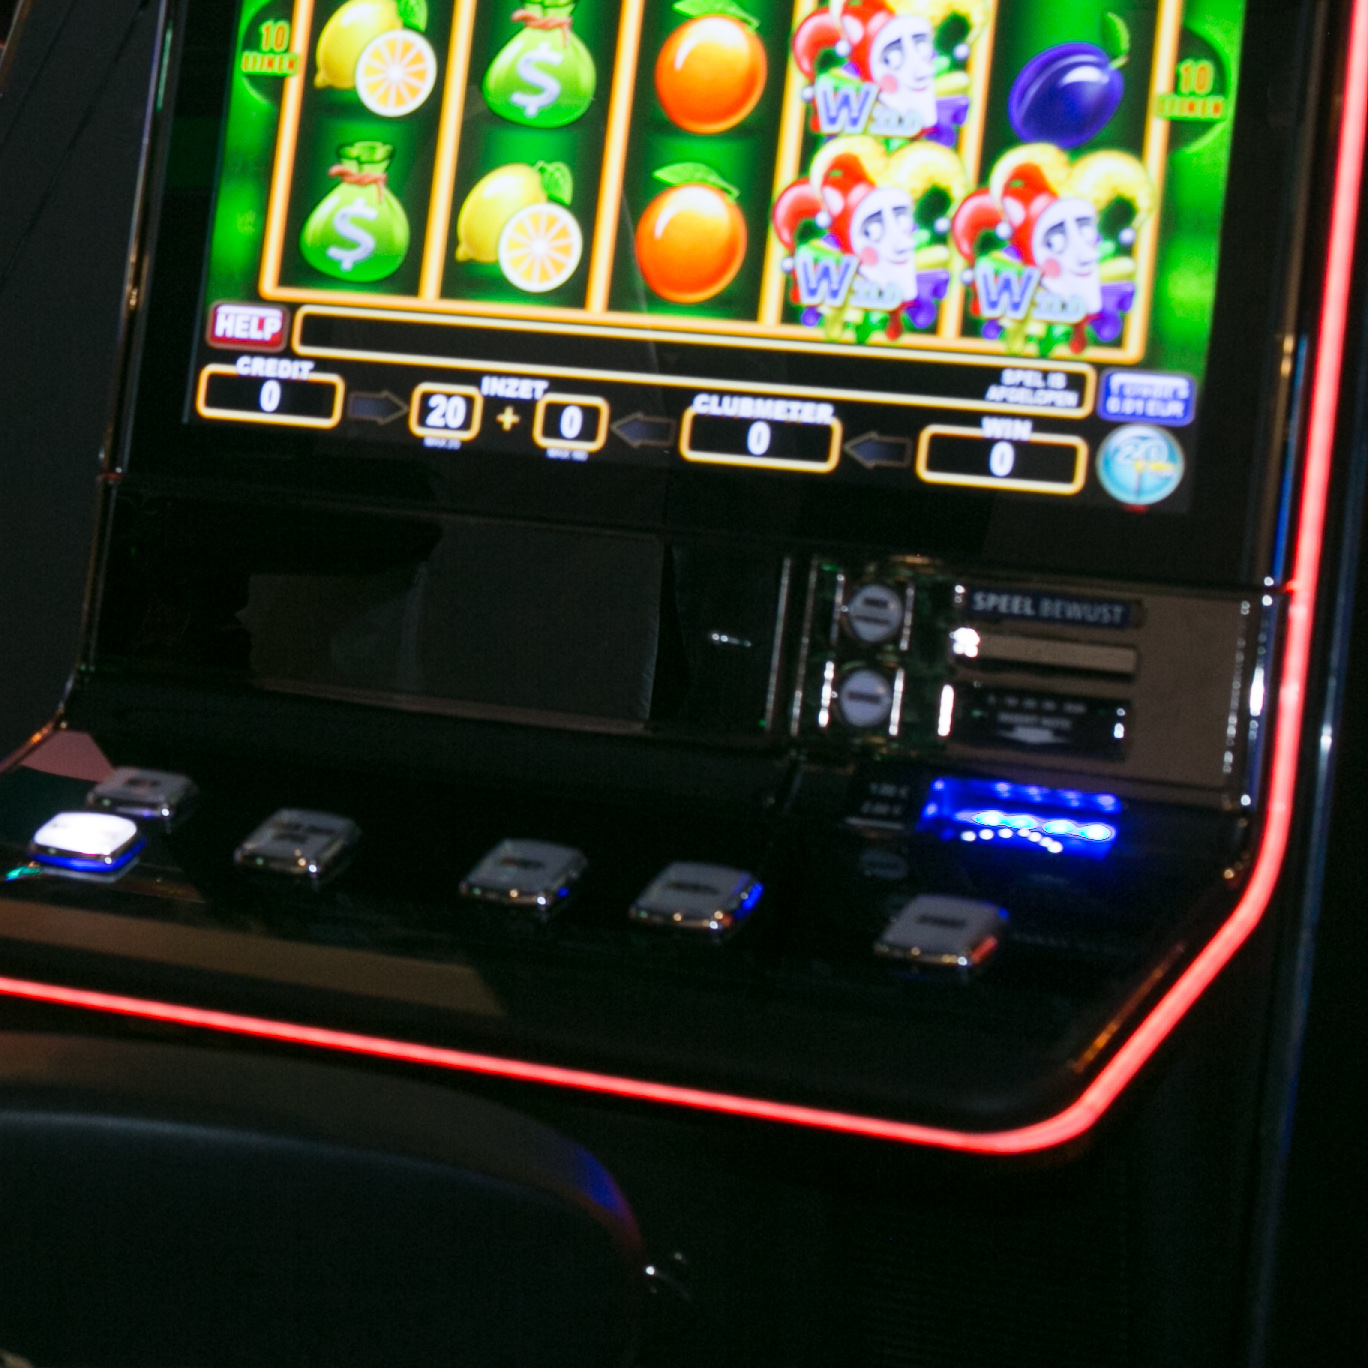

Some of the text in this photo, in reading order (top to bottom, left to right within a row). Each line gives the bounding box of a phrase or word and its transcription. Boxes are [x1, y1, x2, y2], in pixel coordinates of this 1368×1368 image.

[261, 20, 289, 51] 10
[1180, 60, 1214, 94] 10
[215, 313, 282, 340] HELP
[236, 355, 315, 380] CREDIT
[260, 380, 280, 412] 0
[480, 375, 549, 399] INZET
[426, 394, 583, 439] 20 0
[693, 393, 834, 424] CLUBMETER
[747, 421, 771, 456] 0
[981, 416, 1032, 441] WIN
[989, 441, 1014, 477] 0
[973, 591, 1125, 624] SPEEL BEWUST
